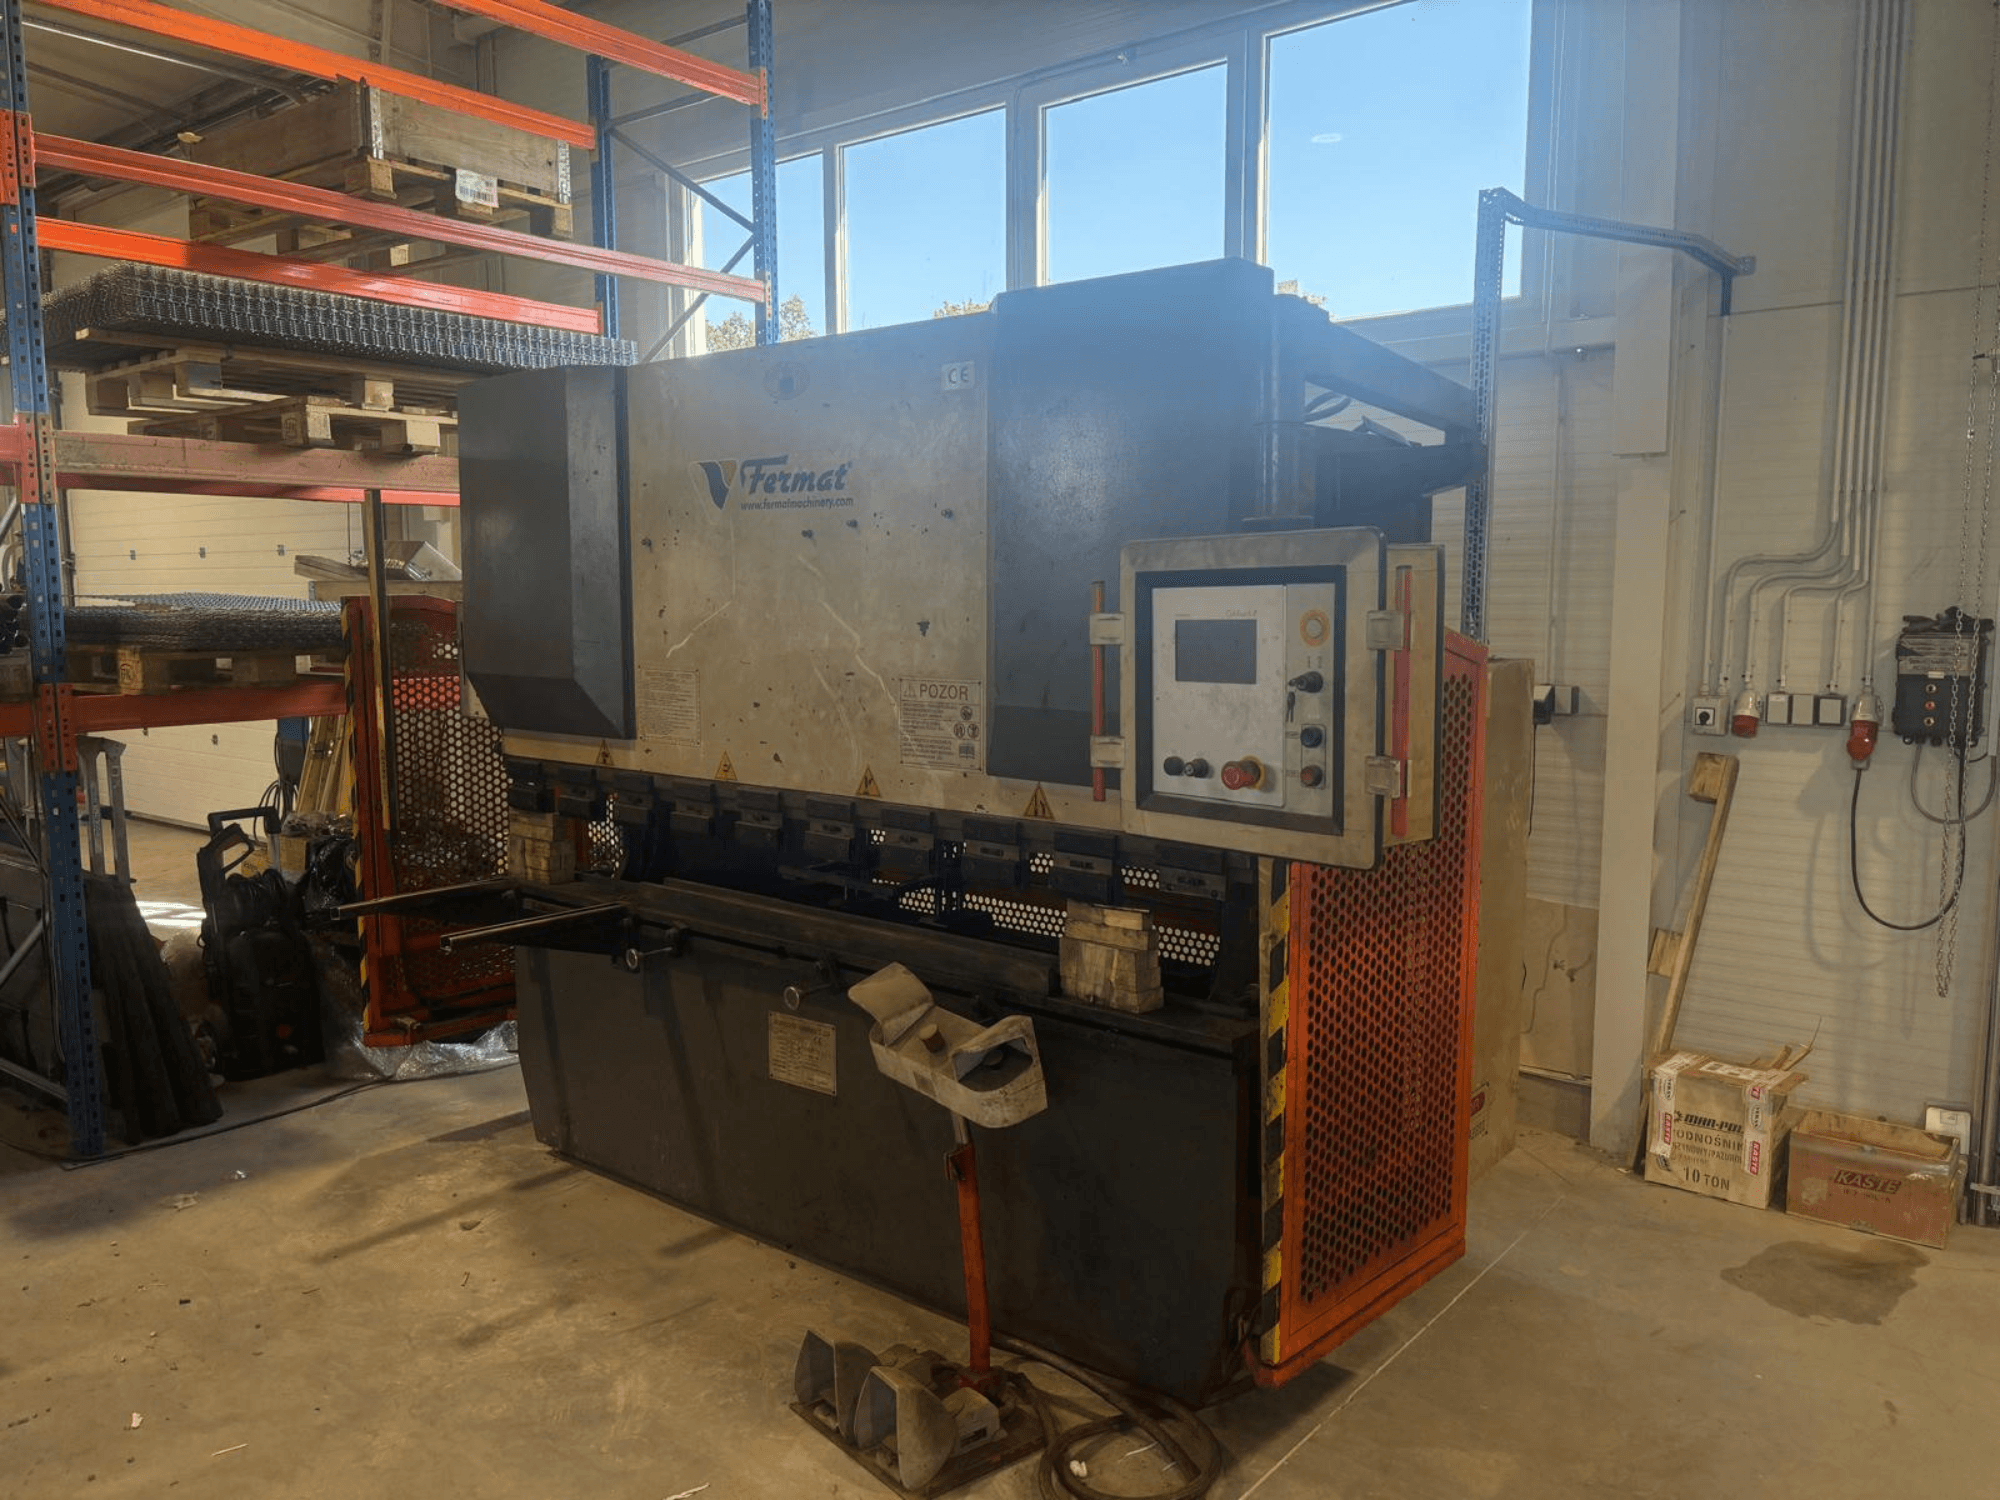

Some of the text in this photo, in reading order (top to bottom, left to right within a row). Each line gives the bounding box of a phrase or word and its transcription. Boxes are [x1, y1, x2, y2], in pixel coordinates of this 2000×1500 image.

[948, 366, 970, 384] CE
[740, 455, 850, 494] Fermat
[741, 496, 854, 511] www.fermatmachinery.com
[919, 683, 969, 701] POZOR
[1672, 1129, 1743, 1151] ODNOŚNIK
[1683, 1166, 1730, 1191] 10 TON
